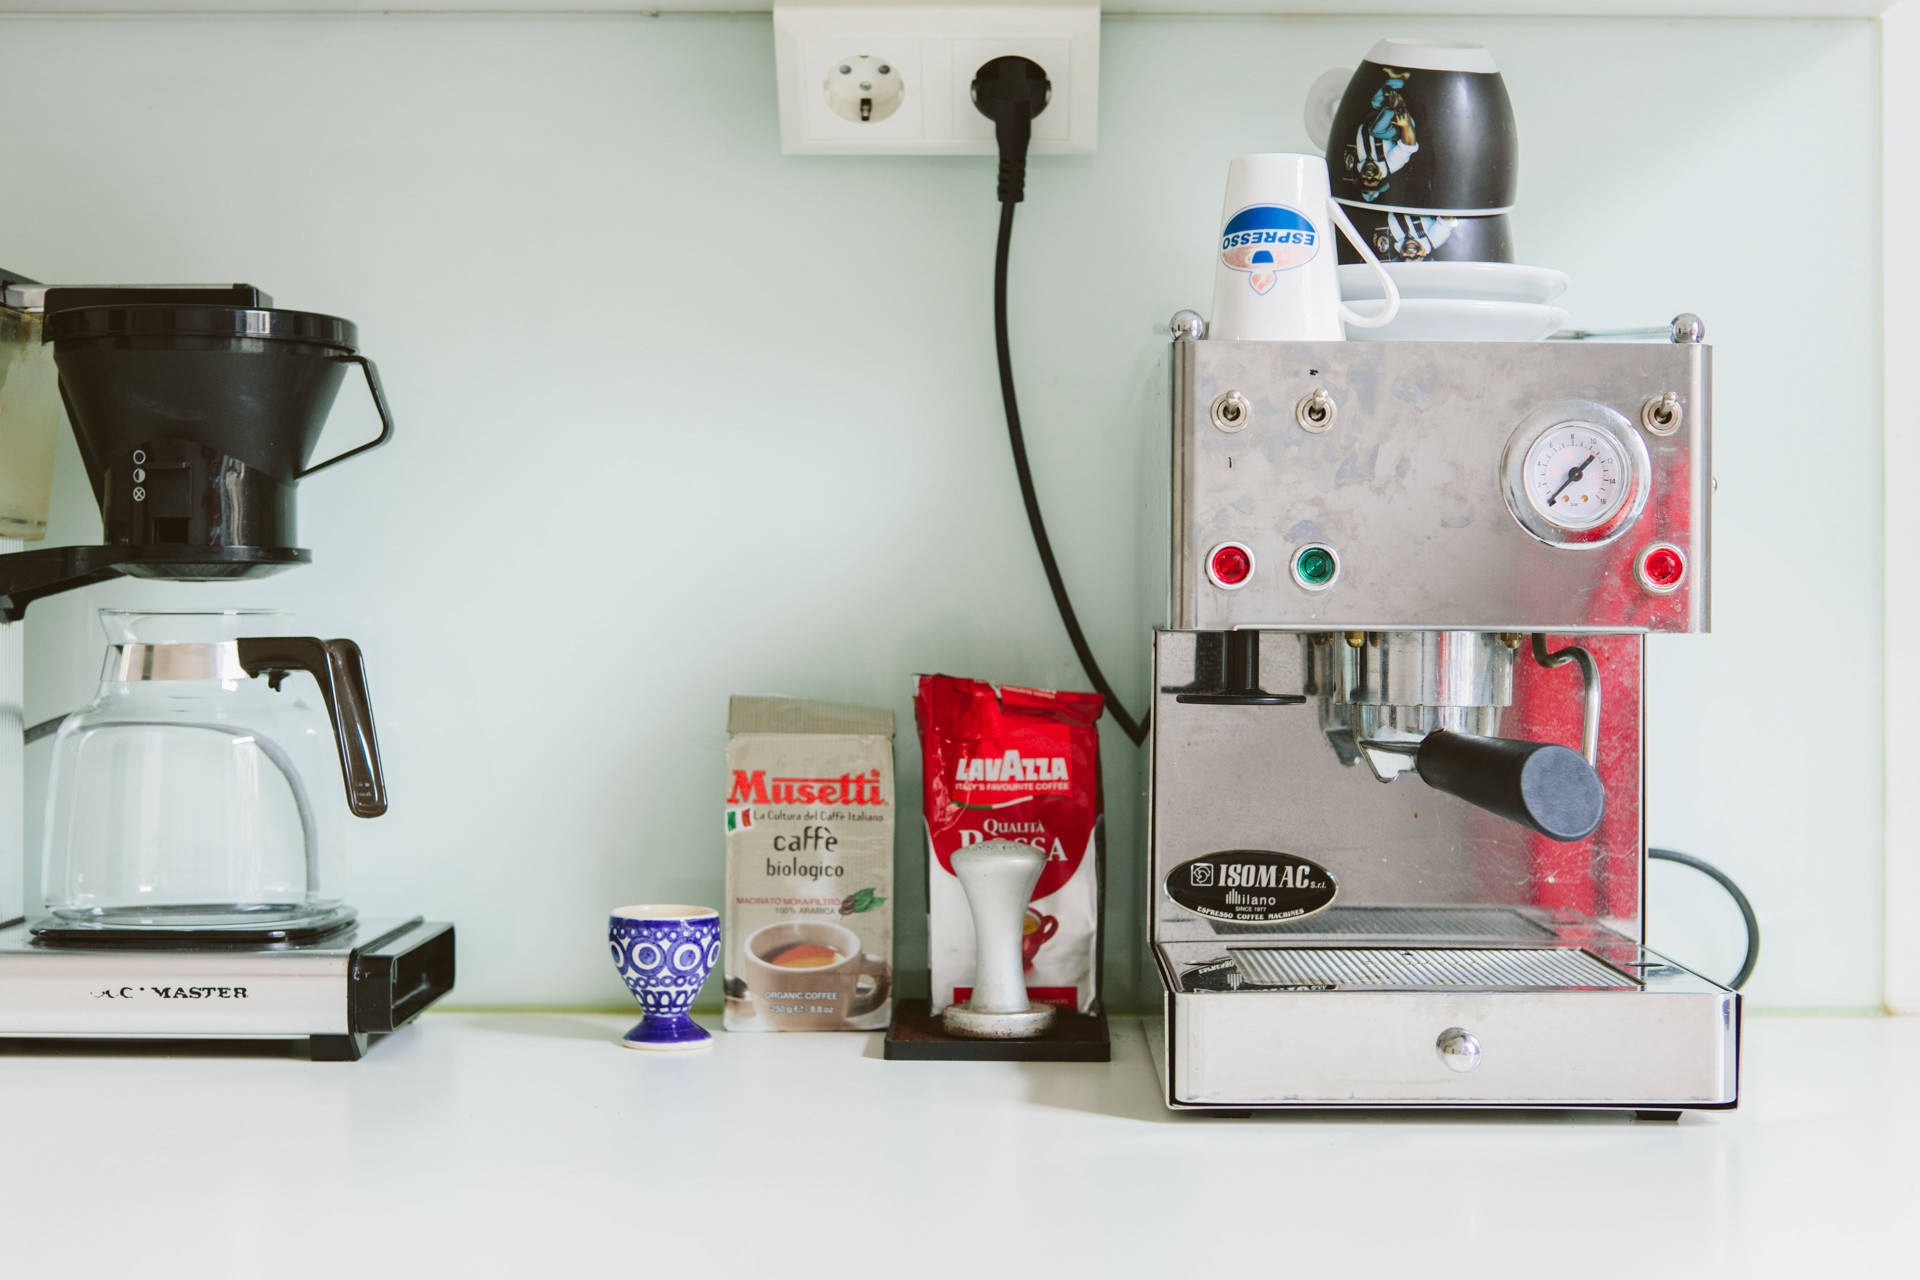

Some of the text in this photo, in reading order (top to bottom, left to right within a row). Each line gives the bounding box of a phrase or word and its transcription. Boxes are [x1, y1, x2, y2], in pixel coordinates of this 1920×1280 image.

[1222, 231, 1315, 250] ESPRESSO
[955, 749, 1069, 781] LAVAZZA
[726, 768, 886, 806] Musetti
[986, 782, 1034, 791] FAVOURITE
[1035, 782, 1070, 791] COFFEE
[753, 811, 766, 820] La
[767, 810, 801, 821] Cultura
[803, 810, 818, 821] del
[847, 810, 884, 822] Italiano
[773, 826, 838, 851] caffè
[766, 857, 845, 881] biologico
[1218, 864, 1311, 889] ISOMAC
[736, 896, 781, 906] MACINATO
[775, 907, 836, 915] 100% ARABICA
[1197, 906, 1234, 919] ESPRESSO
[1268, 908, 1305, 919] MACHINES
[764, 991, 838, 1000] ORGANIC COFFEE
